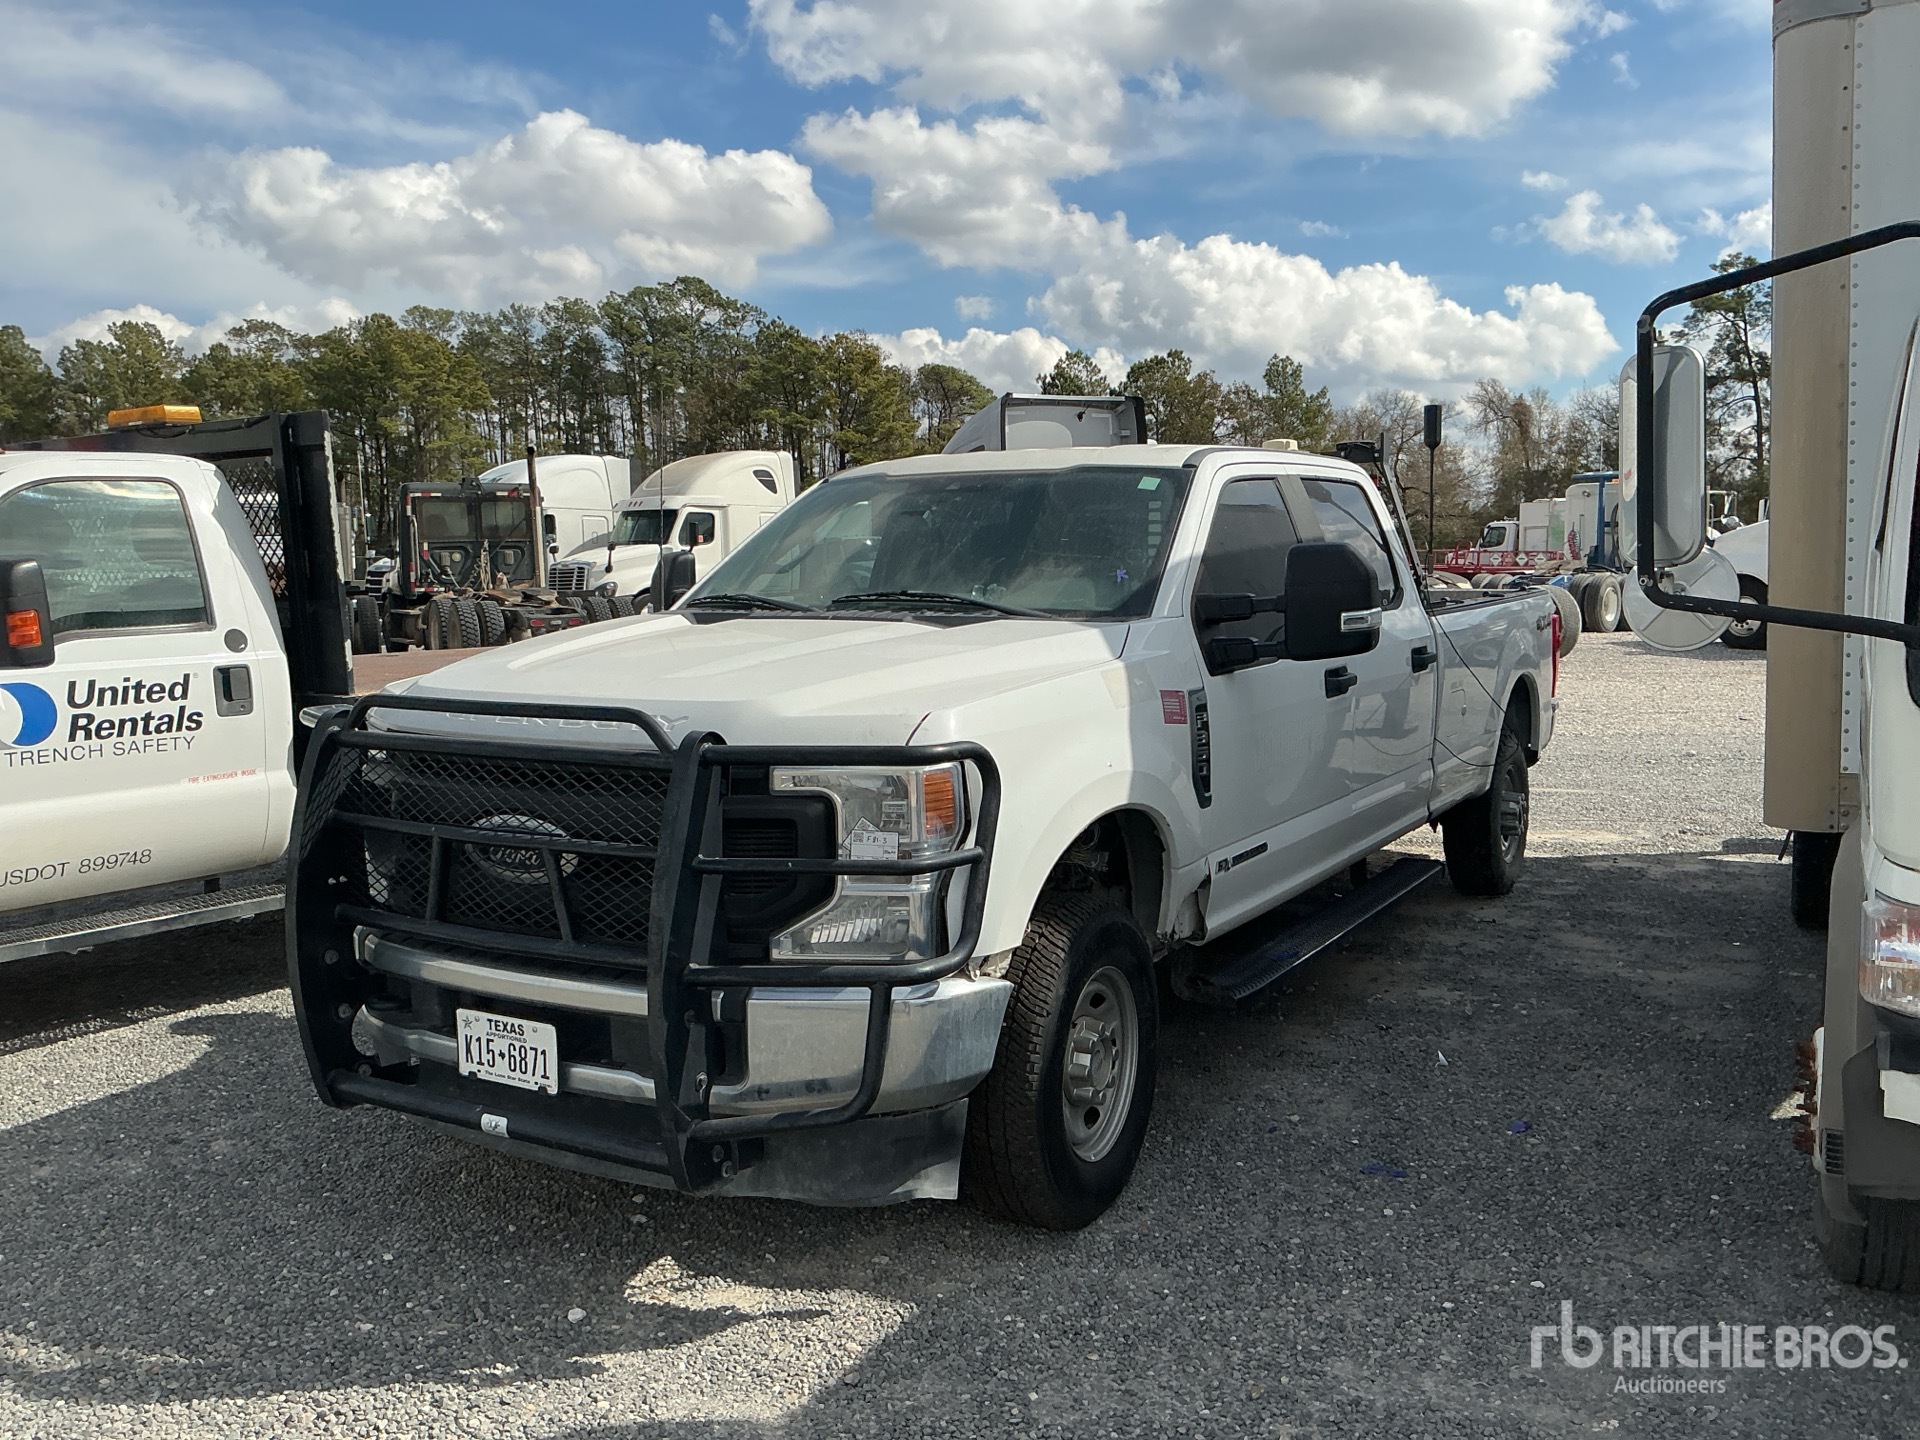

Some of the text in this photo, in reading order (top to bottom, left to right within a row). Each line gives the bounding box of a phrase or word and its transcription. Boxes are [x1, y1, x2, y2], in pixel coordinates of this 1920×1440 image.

[66, 672, 191, 709] United
[67, 705, 204, 742] Rentals
[4, 735, 196, 768] TRENCH SAFETY
[78, 848, 152, 874] 899748
[486, 1018, 525, 1037] TEXAS
